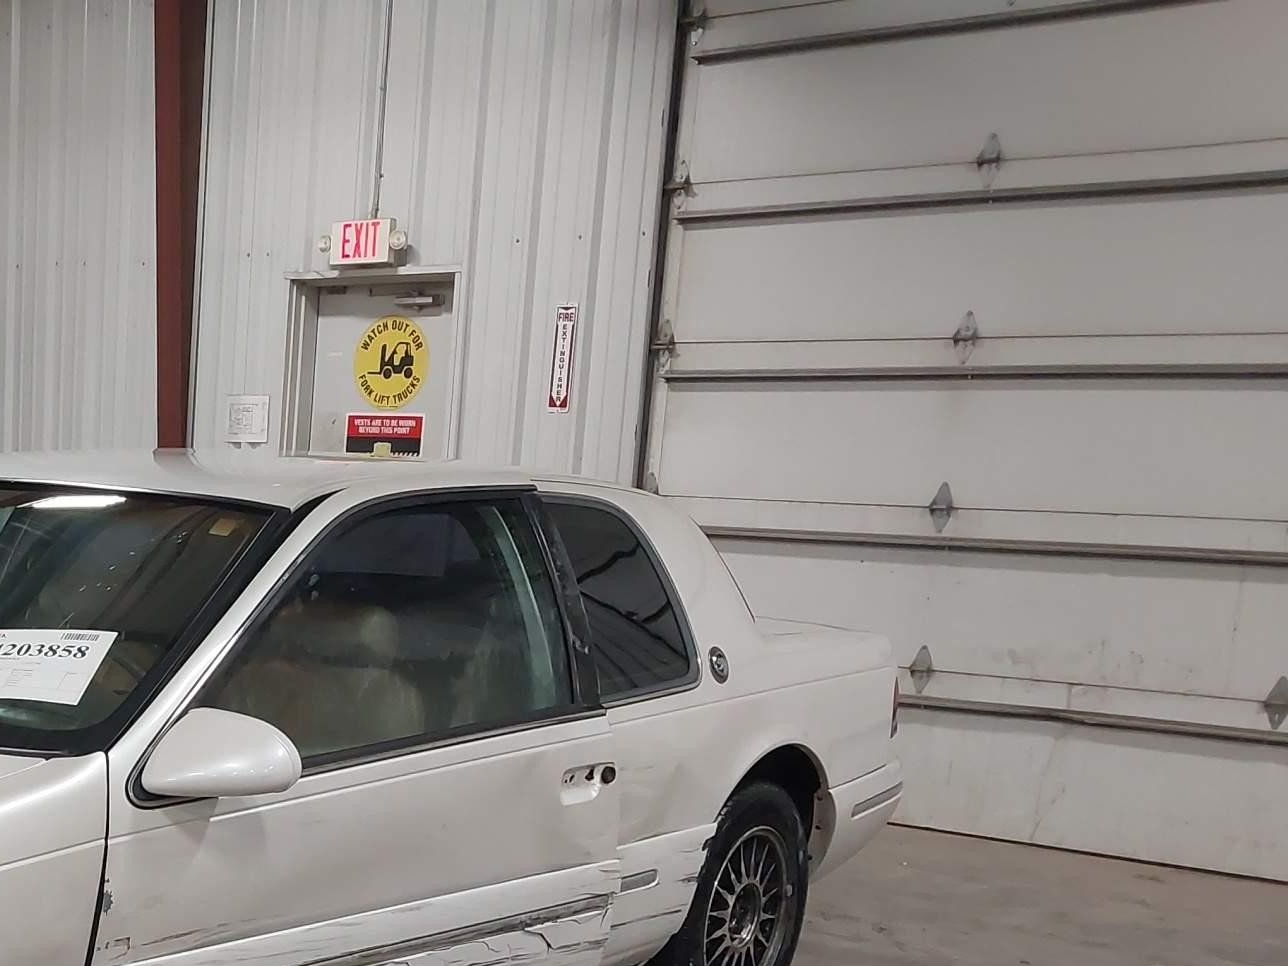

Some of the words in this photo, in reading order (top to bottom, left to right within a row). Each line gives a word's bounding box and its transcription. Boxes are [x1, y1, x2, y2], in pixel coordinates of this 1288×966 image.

[341, 222, 381, 259] EXIT
[558, 312, 575, 322] FIRE
[360, 320, 389, 351] WATCH
[392, 319, 410, 333] OUT
[408, 329, 424, 351] FOR
[556, 323, 568, 402] EXTINGUISHER
[358, 374, 375, 398] FORK
[373, 393, 391, 406] LIFT
[392, 375, 421, 404] TRUCKS
[371, 419, 382, 427] ARE
[382, 419, 390, 427] TO
[393, 427, 410, 435] POINT
